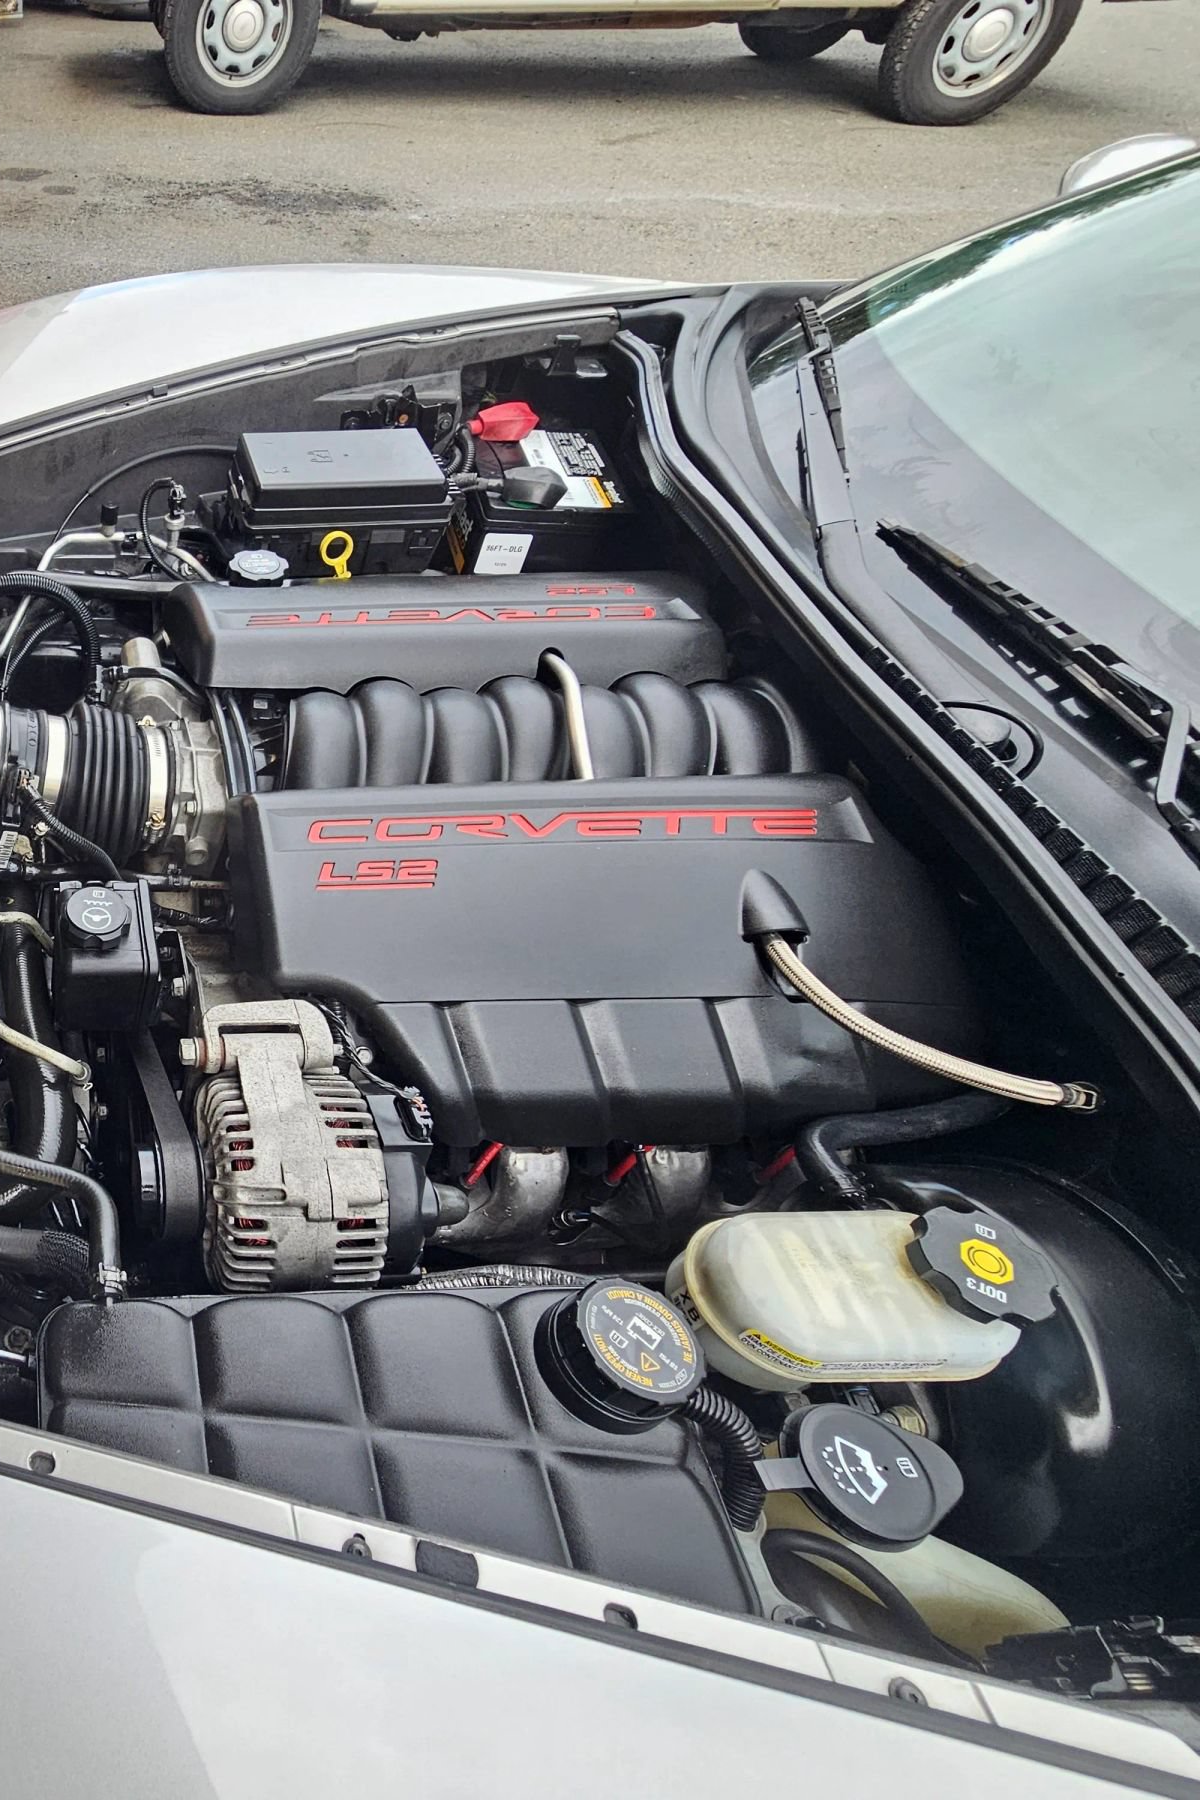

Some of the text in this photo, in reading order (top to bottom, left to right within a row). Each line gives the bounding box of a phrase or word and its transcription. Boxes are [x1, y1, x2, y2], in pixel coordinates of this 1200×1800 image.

[246, 606, 657, 627] CORVETTE
[308, 809, 818, 844] CORVETTE
[318, 859, 439, 882] LS2
[671, 1320, 692, 1352] JAMAIS
[604, 1350, 625, 1373] OPEN
[625, 1369, 653, 1387] NEVER
